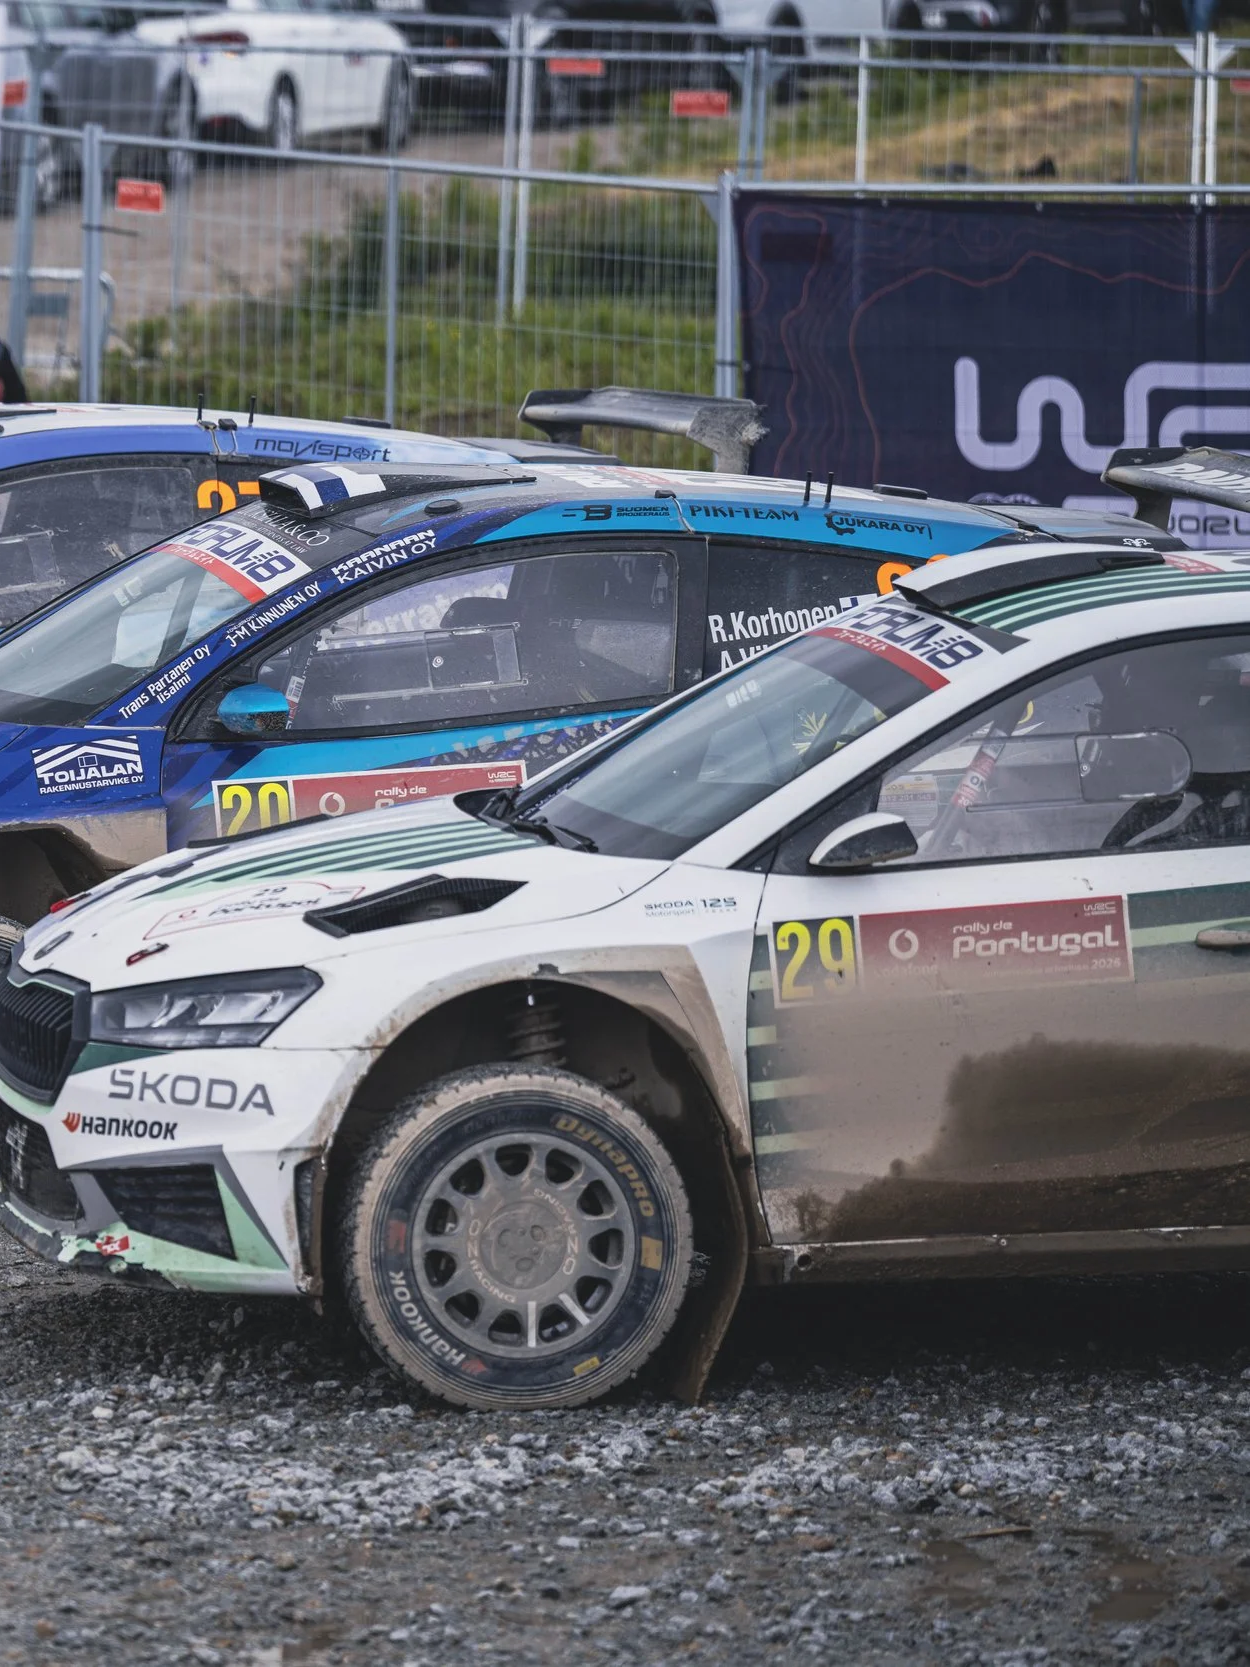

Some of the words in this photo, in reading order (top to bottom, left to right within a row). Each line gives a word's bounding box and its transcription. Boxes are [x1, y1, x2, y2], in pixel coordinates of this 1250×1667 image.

[254, 438, 391, 462] movisport
[690, 504, 800, 522] PIKI-TEAM
[835, 513, 903, 533] JUKARA
[903, 523, 926, 536] OY
[336, 552, 408, 585] KAIVIN
[408, 537, 438, 556] OY
[225, 626, 251, 648] J-M
[247, 594, 307, 632] KINNUNEN
[304, 580, 322, 598] OY
[708, 603, 838, 643] R.Korhonen
[836, 606, 984, 669] FORUM8
[118, 692, 150, 719] Trans
[147, 656, 195, 697] Partanen
[156, 672, 192, 705] Iisalmi
[38, 760, 143, 785] TOIJALAN
[38, 777, 127, 796] RAKENNUSTARVIKE
[128, 775, 144, 785] OY
[221, 782, 289, 837] 20
[374, 786, 407, 798] rally
[409, 784, 428, 795] de
[700, 897, 737, 909] 125
[953, 924, 1120, 960] Portugal
[776, 918, 854, 1001] 29
[953, 921, 991, 935] rally
[992, 921, 1013, 931] de
[1091, 957, 1122, 970] 2026
